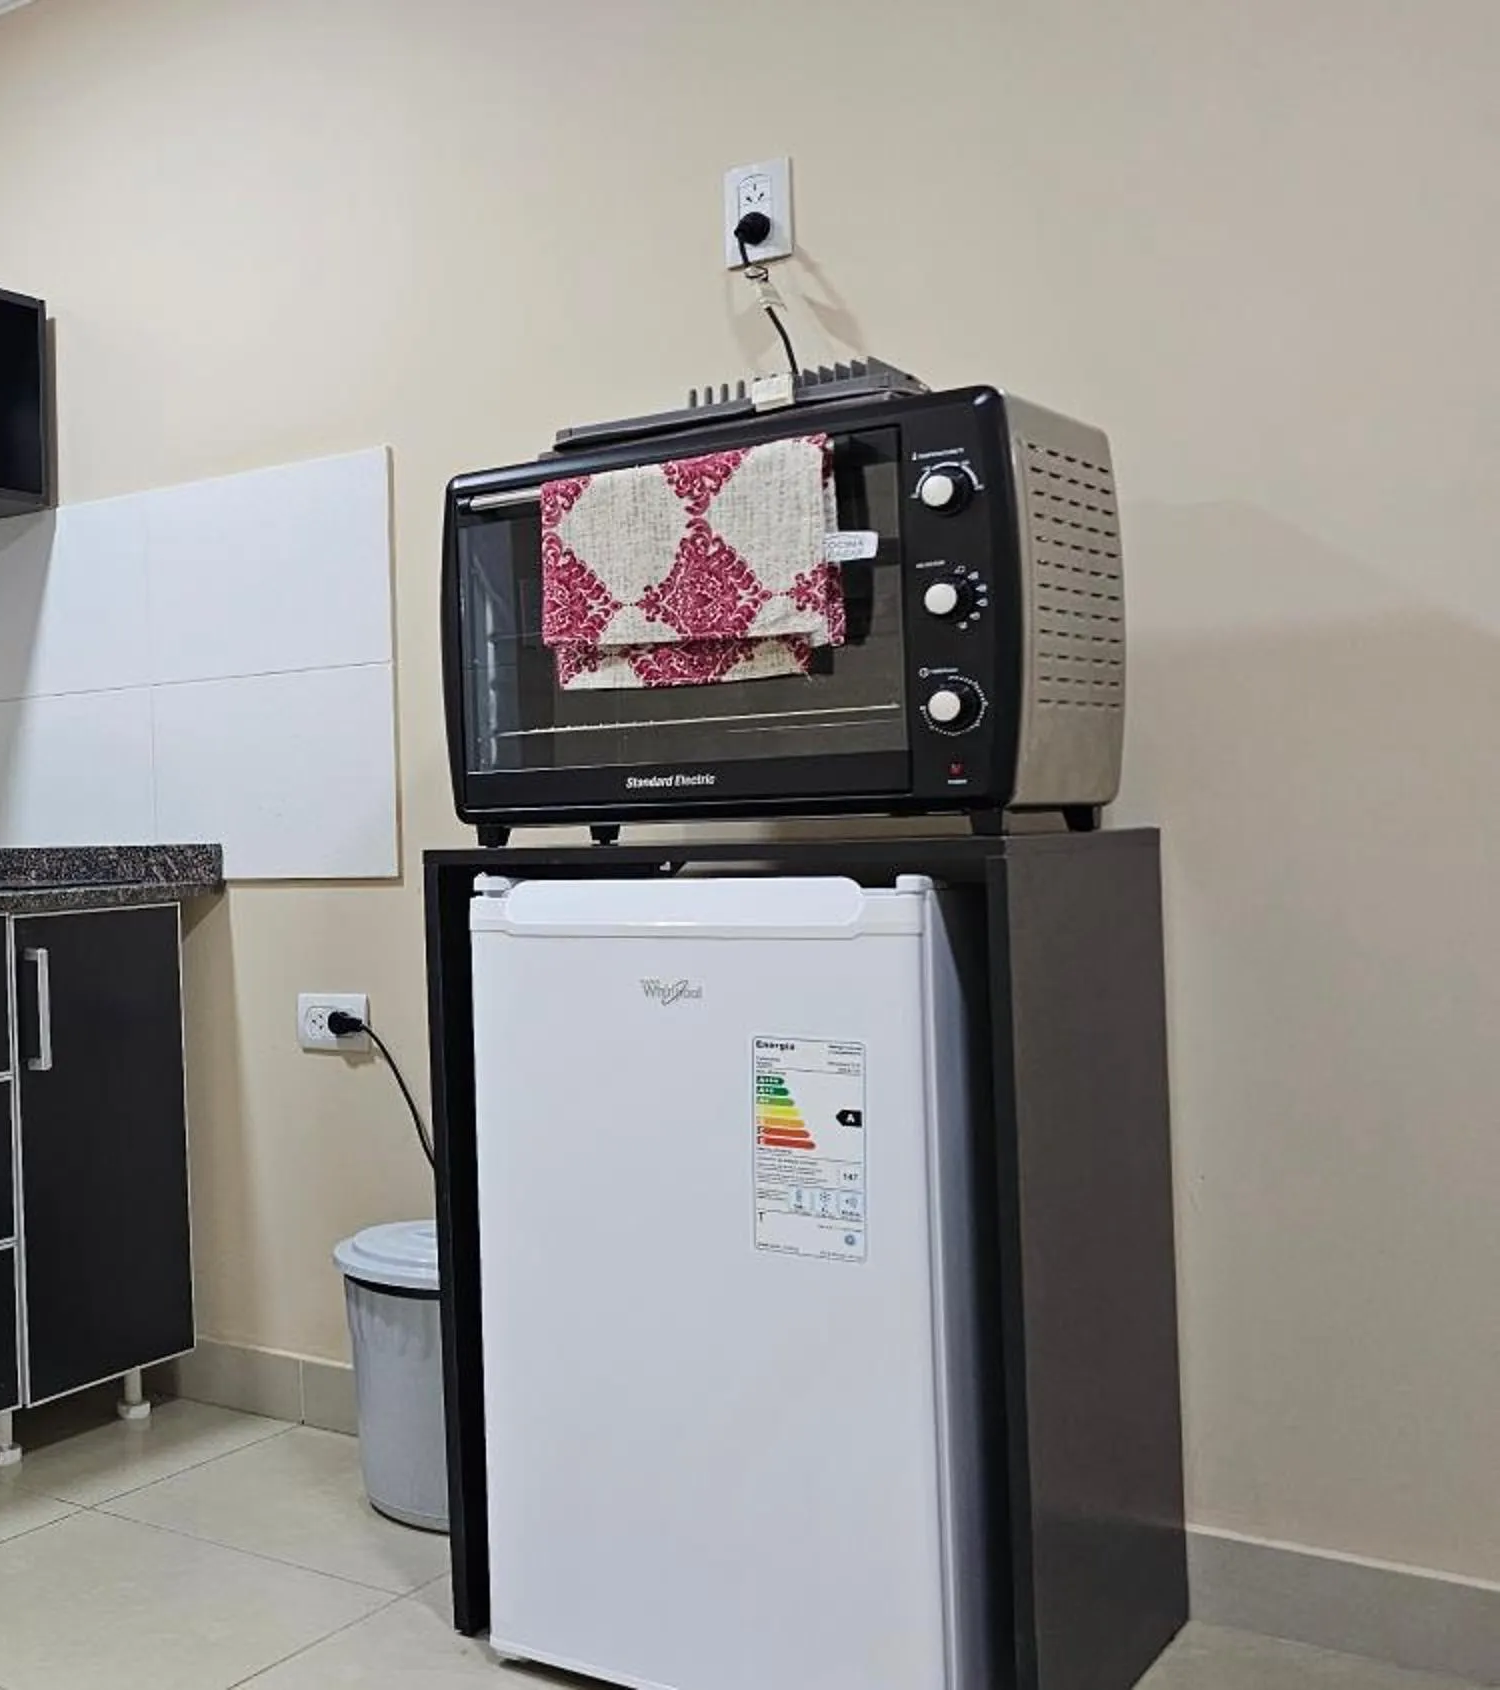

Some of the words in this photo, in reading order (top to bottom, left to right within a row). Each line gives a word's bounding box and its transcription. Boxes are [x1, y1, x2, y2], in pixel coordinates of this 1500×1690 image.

[625, 774, 673, 789] Standard
[674, 773, 716, 787] Electric
[845, 1113, 855, 1123] A
